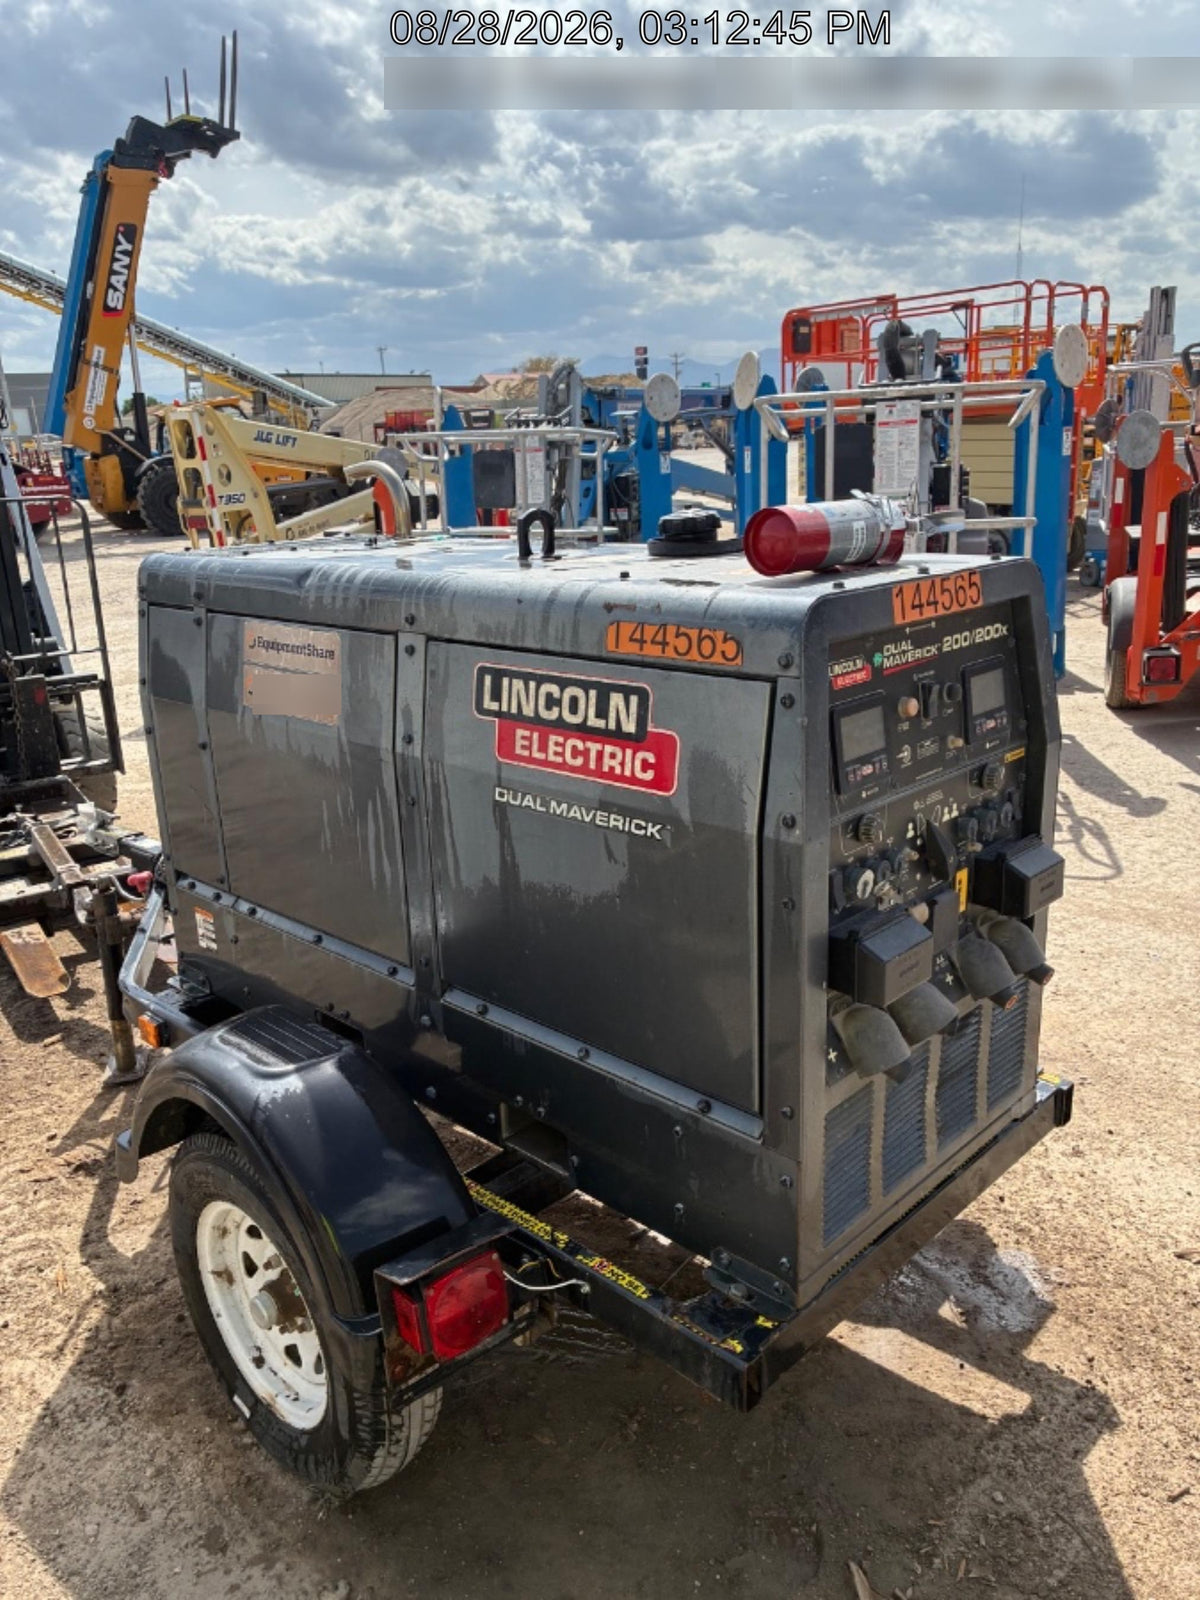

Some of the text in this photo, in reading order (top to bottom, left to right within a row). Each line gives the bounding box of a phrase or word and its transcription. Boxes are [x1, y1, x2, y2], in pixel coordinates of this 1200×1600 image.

[107, 233, 134, 310] SANY
[254, 430, 297, 448] JLG LIFT
[218, 493, 246, 505] T350
[896, 570, 981, 621] 144565
[257, 636, 335, 660] EquipmentShare
[615, 621, 741, 662] 144565
[883, 639, 914, 656] DUAL
[828, 658, 864, 676] LINCOLN
[883, 647, 938, 669] MAVERICK
[482, 674, 639, 734] LINCOLN
[515, 728, 656, 781] ELECTRIC
[495, 786, 663, 840] DUAL MAVERICK
